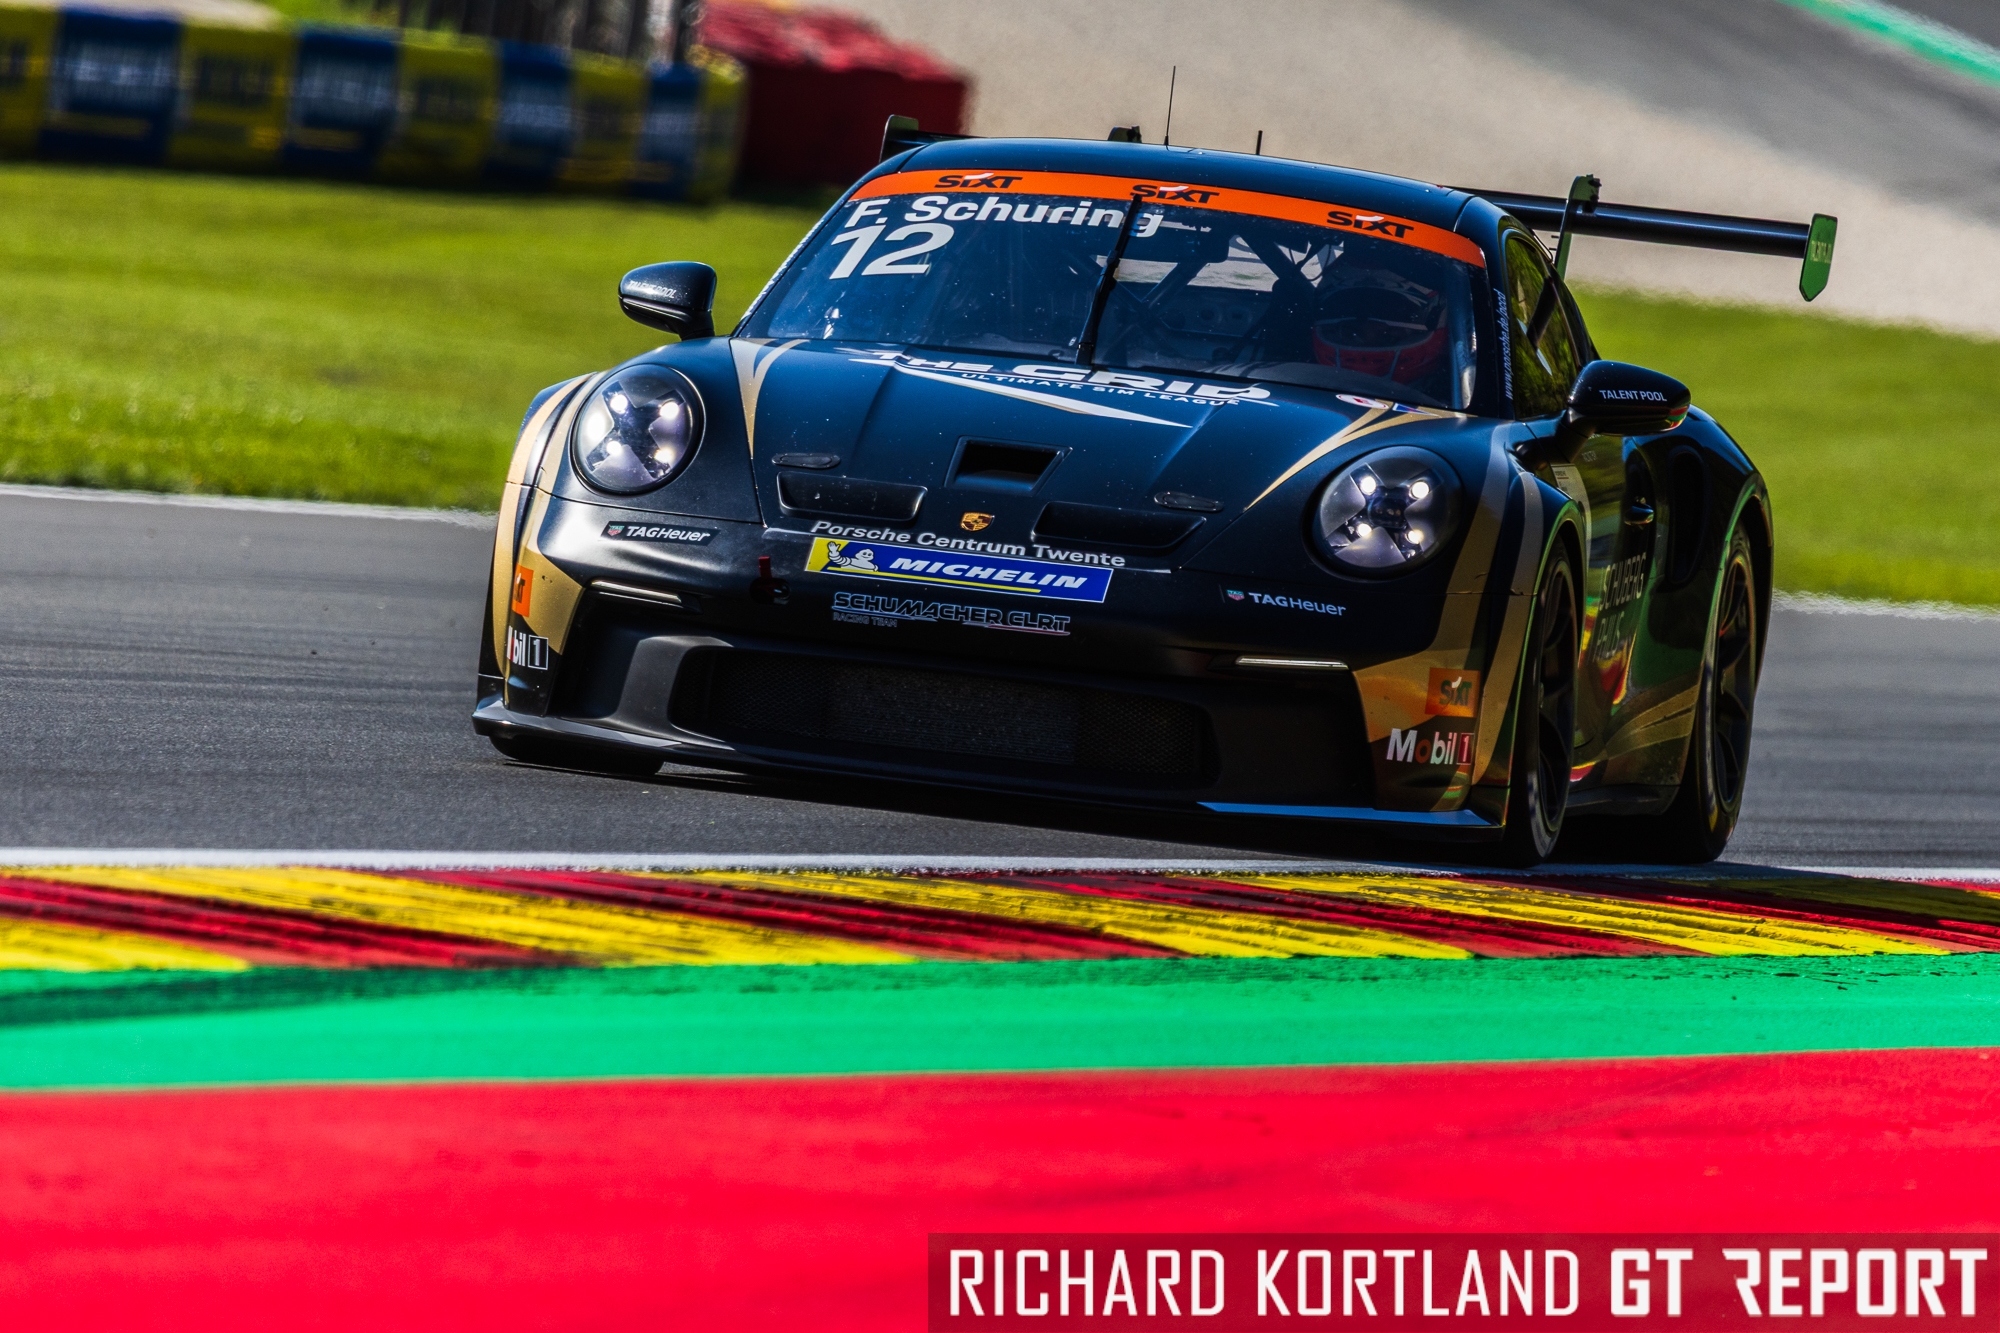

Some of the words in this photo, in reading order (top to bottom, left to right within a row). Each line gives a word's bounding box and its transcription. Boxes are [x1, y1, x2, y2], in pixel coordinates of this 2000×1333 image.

[844, 198, 891, 228] F.
[904, 195, 1164, 238] Schuring
[829, 222, 955, 280] 12
[872, 351, 994, 373] THE
[1012, 364, 1271, 400] GRID
[961, 373, 1084, 390] ULTIMATE
[1092, 386, 1135, 396] SIM
[1143, 392, 1240, 406] LEAGUE
[1599, 389, 1639, 400] TALENT
[1639, 390, 1667, 402] POOL
[810, 520, 911, 543] Porsche
[917, 532, 1026, 556] Centrum
[1032, 544, 1126, 567] Twente
[889, 557, 1088, 589] MICHELIN
[1598, 551, 1647, 611] SCHUBERG
[833, 591, 1003, 625] SCHUMACHER
[1008, 610, 1071, 633] CLRT
[833, 611, 870, 625] RACING
[871, 616, 898, 628] TEAM
[1386, 727, 1458, 765] Mobil
